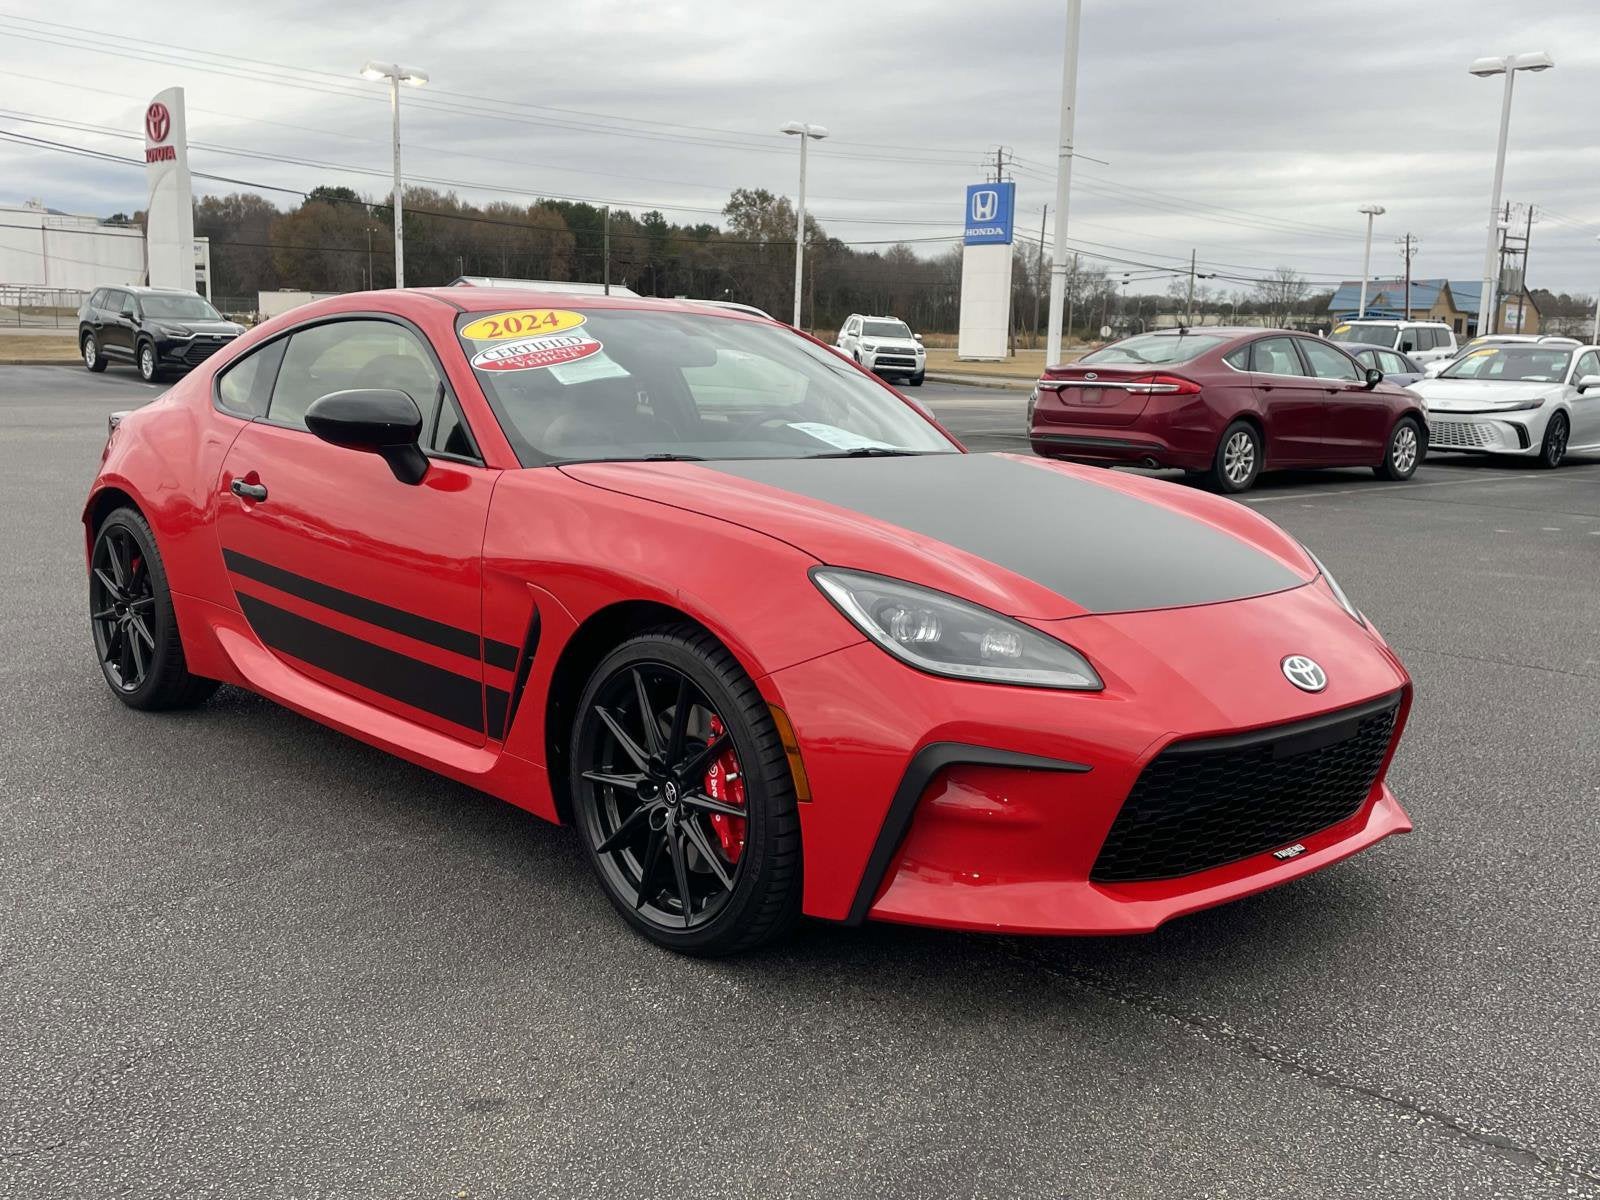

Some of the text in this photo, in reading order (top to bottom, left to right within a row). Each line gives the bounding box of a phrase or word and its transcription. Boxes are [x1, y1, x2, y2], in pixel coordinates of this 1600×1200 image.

[966, 227, 1004, 236] HONDA
[482, 311, 560, 338] 2024
[482, 336, 583, 360] CERTIFIED
[497, 344, 586, 367] PRE-OWNED
[515, 352, 579, 368] VEHICLE
[710, 778, 721, 821] breo
